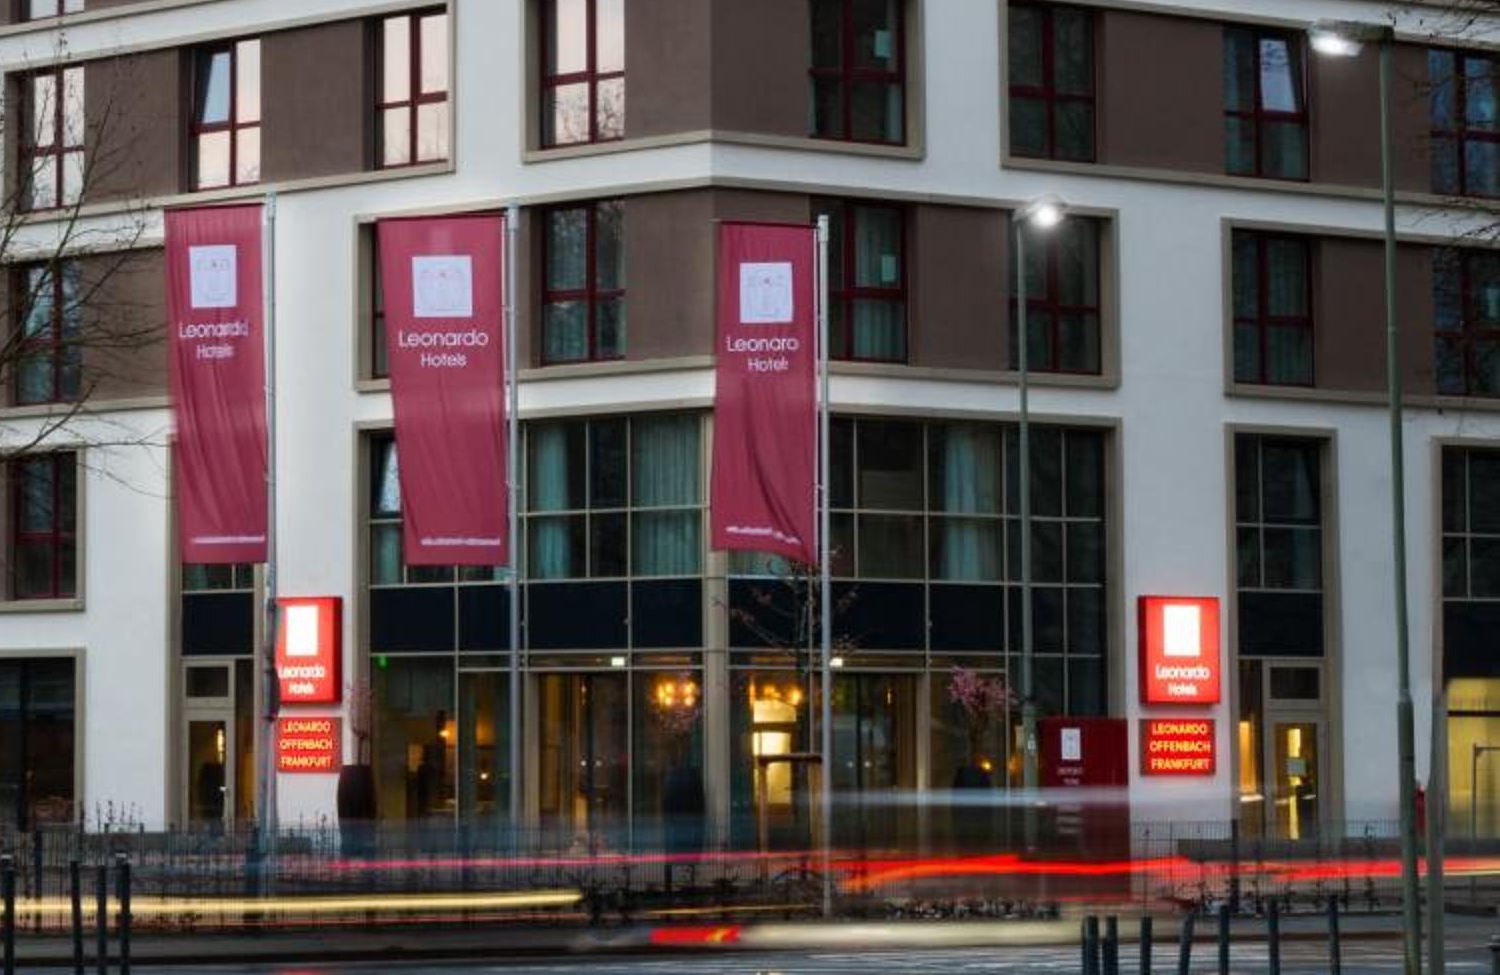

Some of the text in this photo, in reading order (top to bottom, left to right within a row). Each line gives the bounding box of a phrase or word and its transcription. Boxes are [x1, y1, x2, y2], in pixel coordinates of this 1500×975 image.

[399, 329, 489, 347] Leonardo
[726, 336, 799, 352] Leonaro
[420, 353, 467, 367] Hotels
[278, 665, 325, 679] Leonardo
[1155, 665, 1210, 680] Leonardo
[1168, 683, 1197, 696] Hotels
[283, 721, 330, 733] LEONARDO
[1152, 723, 1207, 735] LEONARDO
[280, 738, 332, 750] OFFENBACH
[1150, 740, 1211, 752] OFFENBACH
[281, 756, 330, 768] FRANKFURT
[1151, 758, 1210, 770] FRANKFURT
